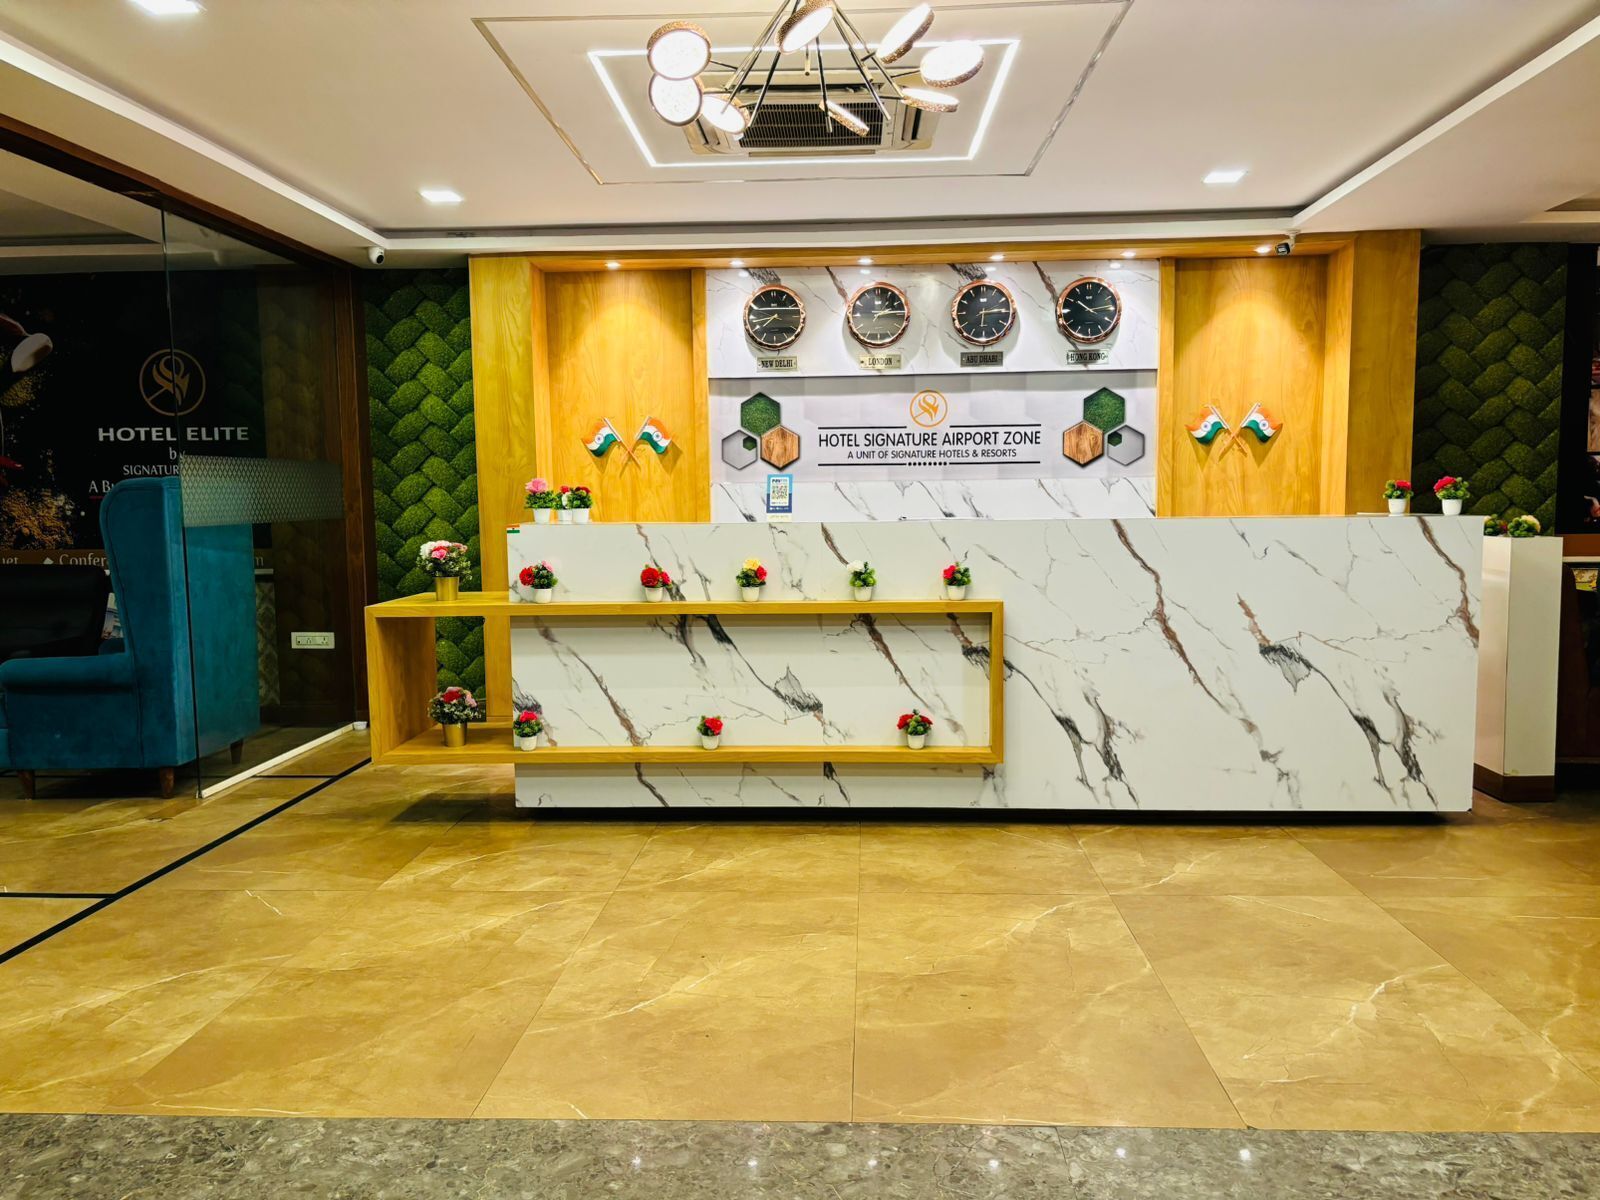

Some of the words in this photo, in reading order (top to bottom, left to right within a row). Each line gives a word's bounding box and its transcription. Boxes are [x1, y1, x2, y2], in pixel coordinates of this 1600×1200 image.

[868, 358, 892, 366] LONDON
[966, 355, 978, 363] ABU
[979, 355, 998, 363] DHABI
[1070, 353, 1087, 361] HONG
[1088, 352, 1105, 360] KONG
[761, 360, 773, 368] NEW
[775, 359, 793, 368] DELHI
[98, 427, 177, 441] HOTEL
[186, 427, 249, 441] ELITE
[818, 433, 860, 447] HOTEL
[864, 432, 938, 447] SIGNATURE
[942, 431, 999, 446] AIRPORT
[1003, 431, 1041, 445] ZONE
[847, 450, 854, 459] A
[856, 450, 875, 459] UNIT
[877, 450, 889, 459] OF
[891, 449, 937, 459] SIGNATURE
[939, 449, 970, 458] HOTELS
[971, 449, 979, 458] &
[981, 448, 1017, 458] RESORTS
[122, 464, 180, 475] SIGNATUR
[88, 480, 98, 493] A
